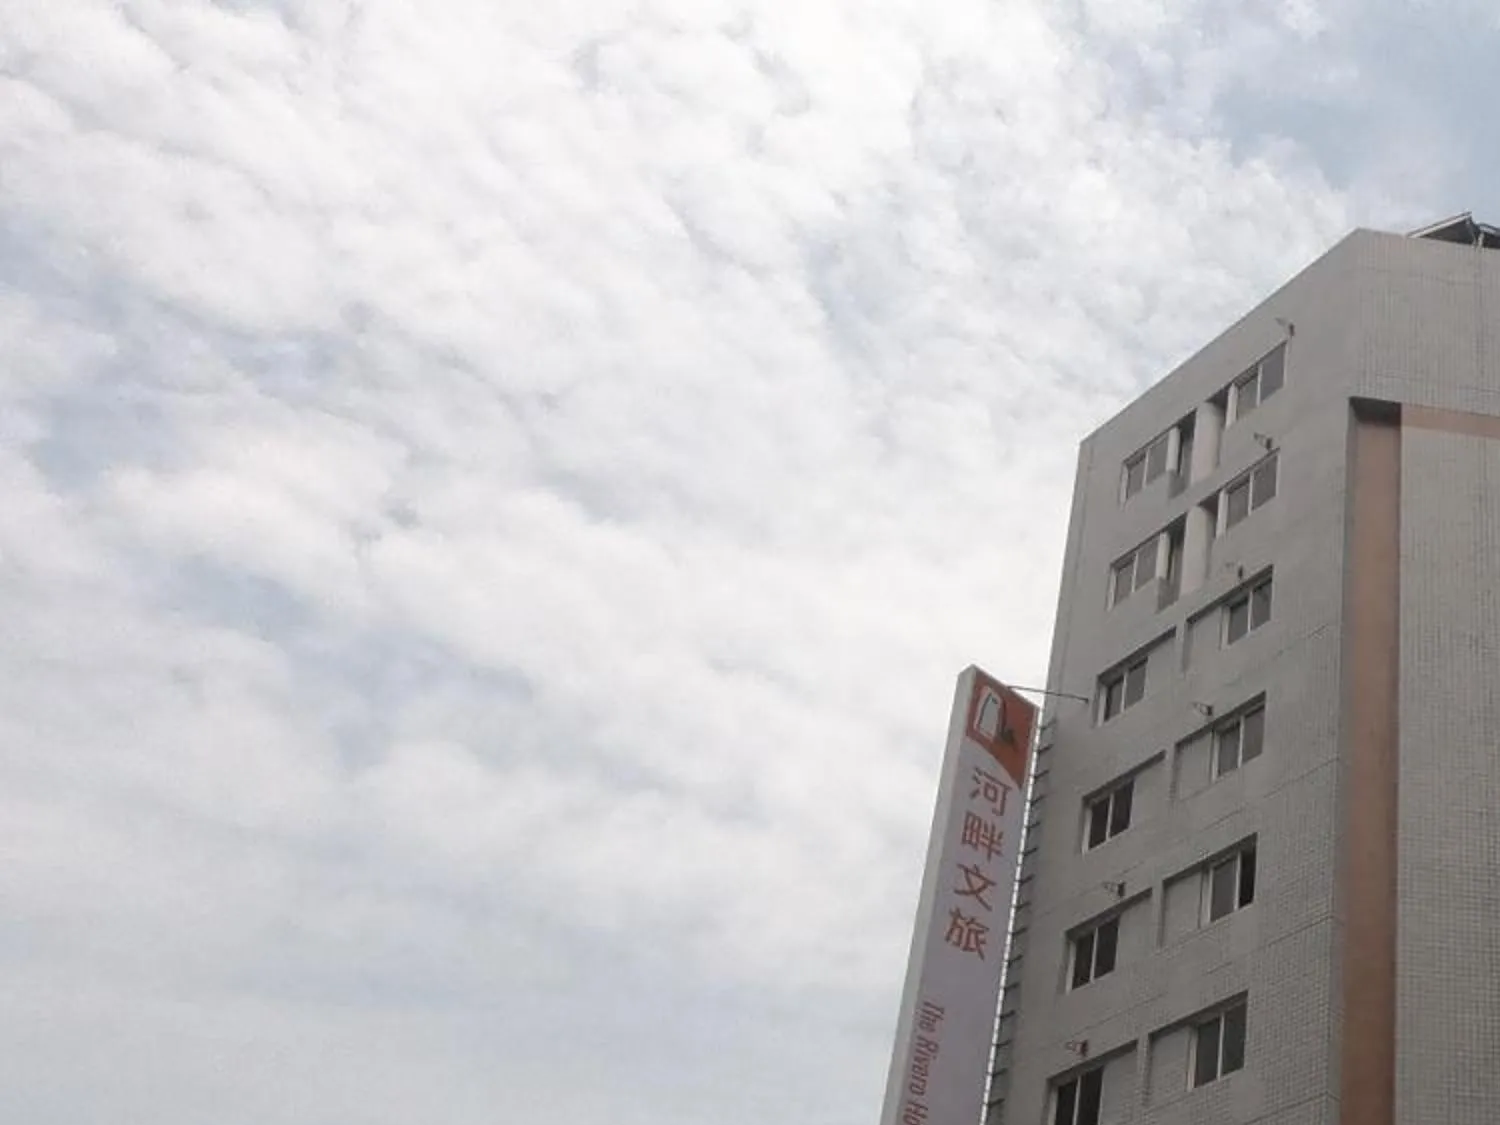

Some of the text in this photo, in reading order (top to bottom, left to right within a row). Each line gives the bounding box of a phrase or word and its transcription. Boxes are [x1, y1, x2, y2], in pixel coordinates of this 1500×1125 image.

[944, 765, 1012, 961] 河畔文旅
[918, 1000, 945, 1032] The
